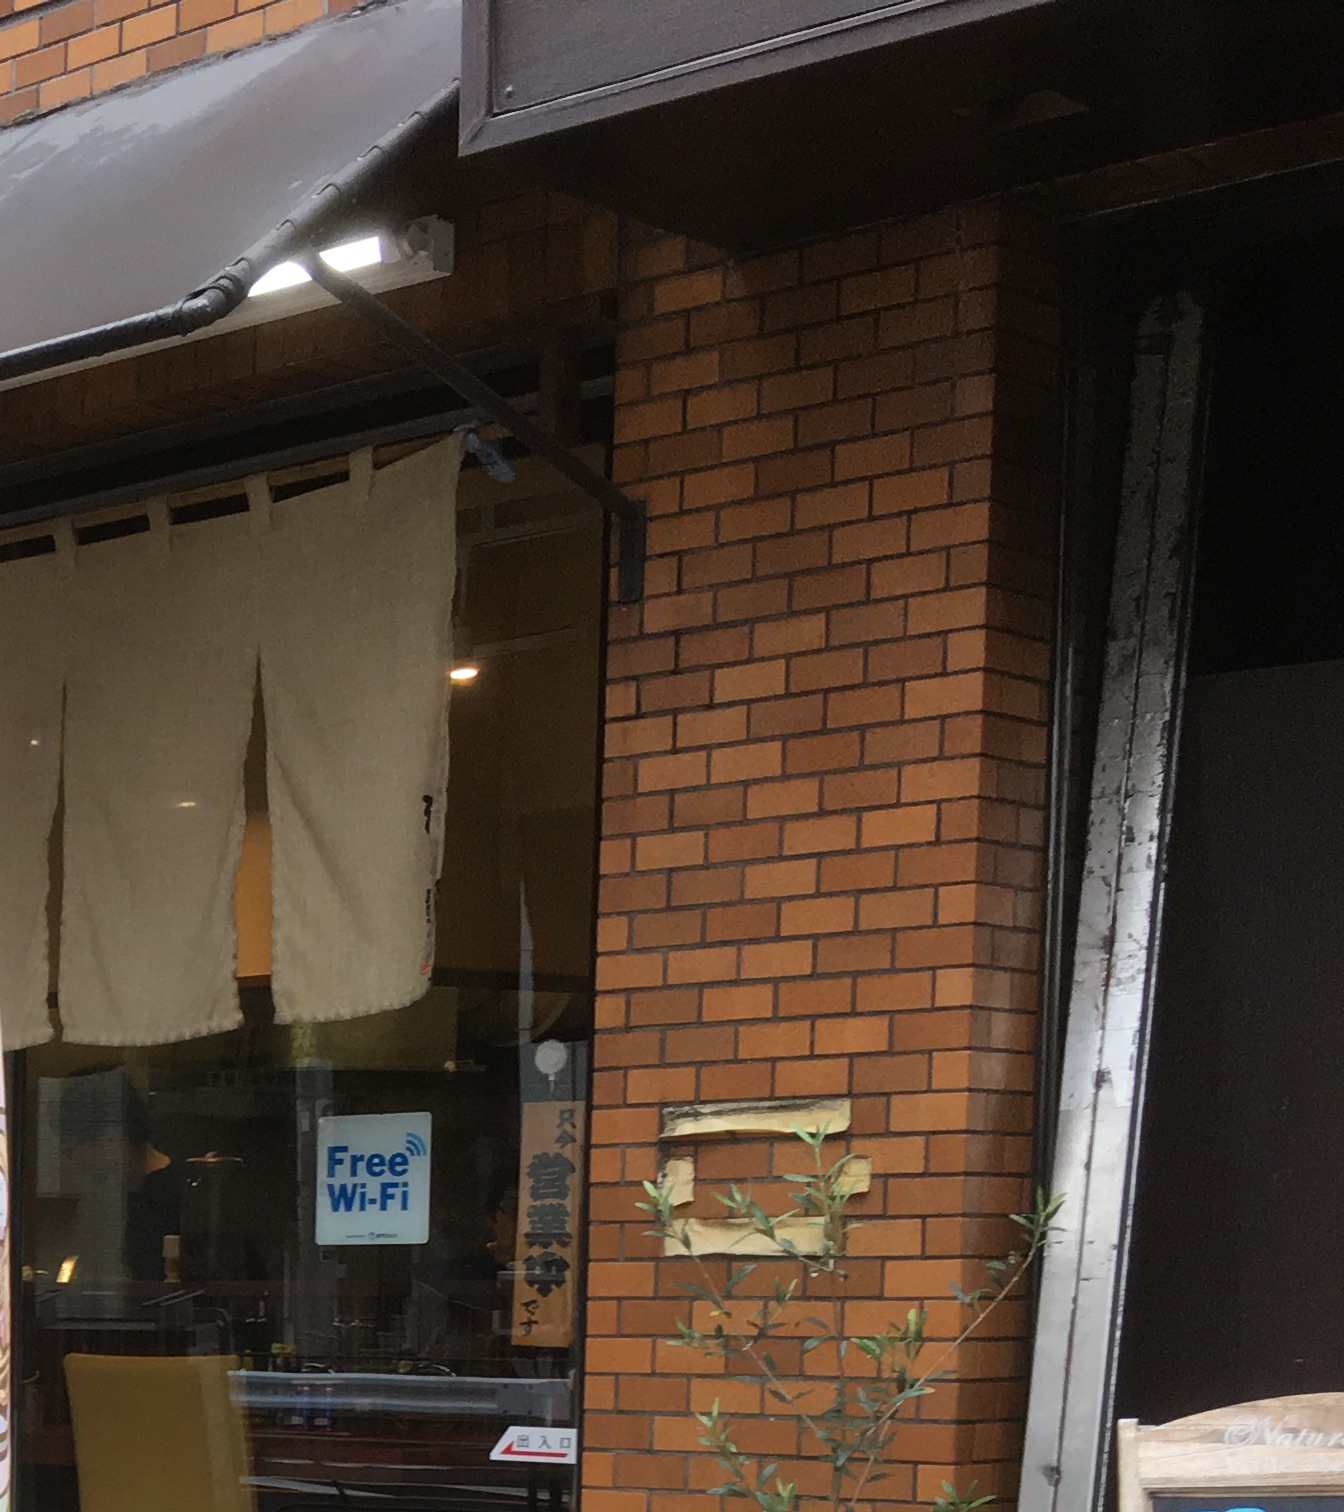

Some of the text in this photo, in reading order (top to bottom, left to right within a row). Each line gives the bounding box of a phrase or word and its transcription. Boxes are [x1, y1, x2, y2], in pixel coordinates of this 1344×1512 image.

[326, 1145, 410, 1178] Free
[326, 1181, 410, 1213] Wi-Fi
[516, 1433, 572, 1449] 出入口
[1223, 1412, 1344, 1447] Natur
